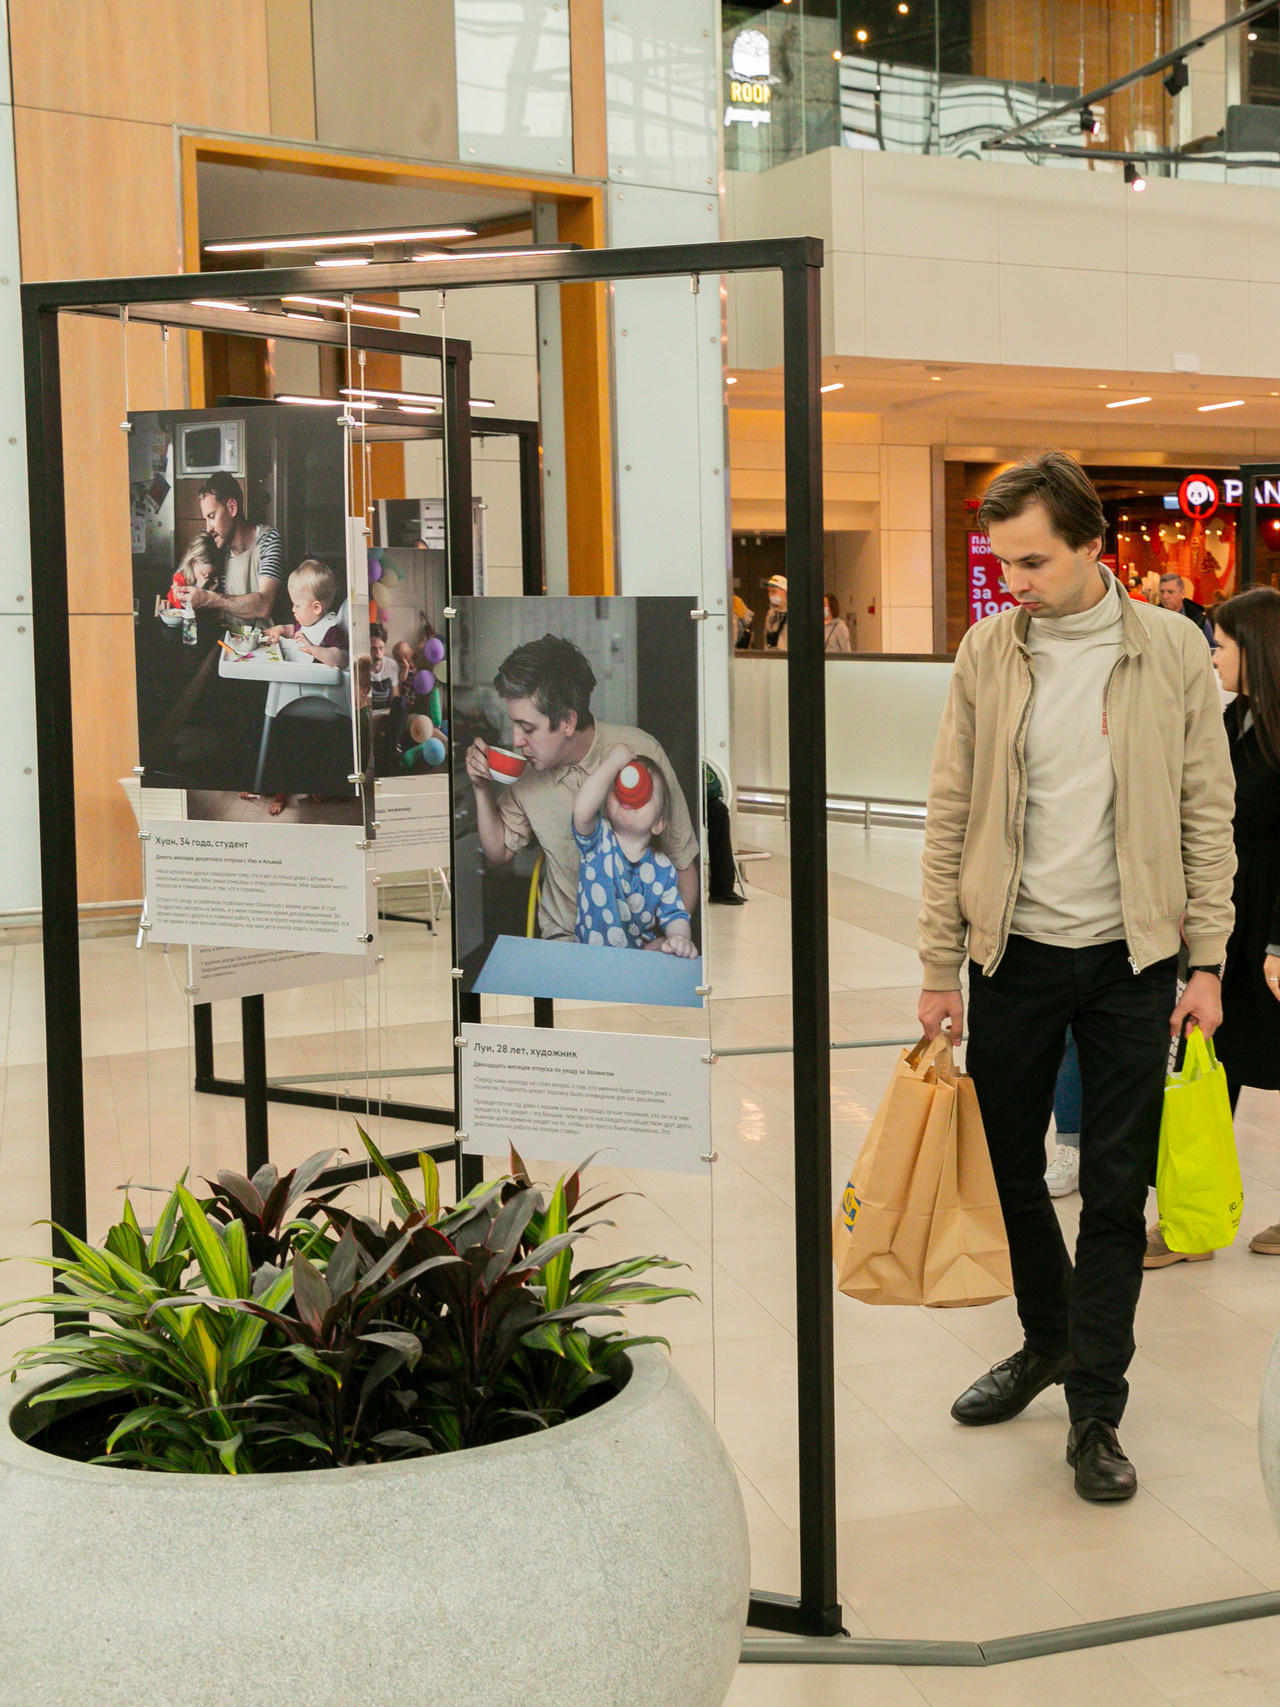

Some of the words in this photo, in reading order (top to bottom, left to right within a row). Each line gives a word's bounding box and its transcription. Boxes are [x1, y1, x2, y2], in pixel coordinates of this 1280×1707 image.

[972, 566, 986, 587] 5
[972, 588, 991, 600] за
[155, 837, 179, 848] Хуан,
[179, 837, 191, 846] 34
[192, 840, 214, 848] года,
[215, 840, 249, 850] студент
[473, 1042, 495, 1055] Луи,
[496, 1043, 508, 1053] 28
[509, 1046, 529, 1056] лет,
[530, 1048, 578, 1060] художник
[473, 1061, 507, 1070] Двенадцать
[586, 1068, 615, 1076] Эллингом
